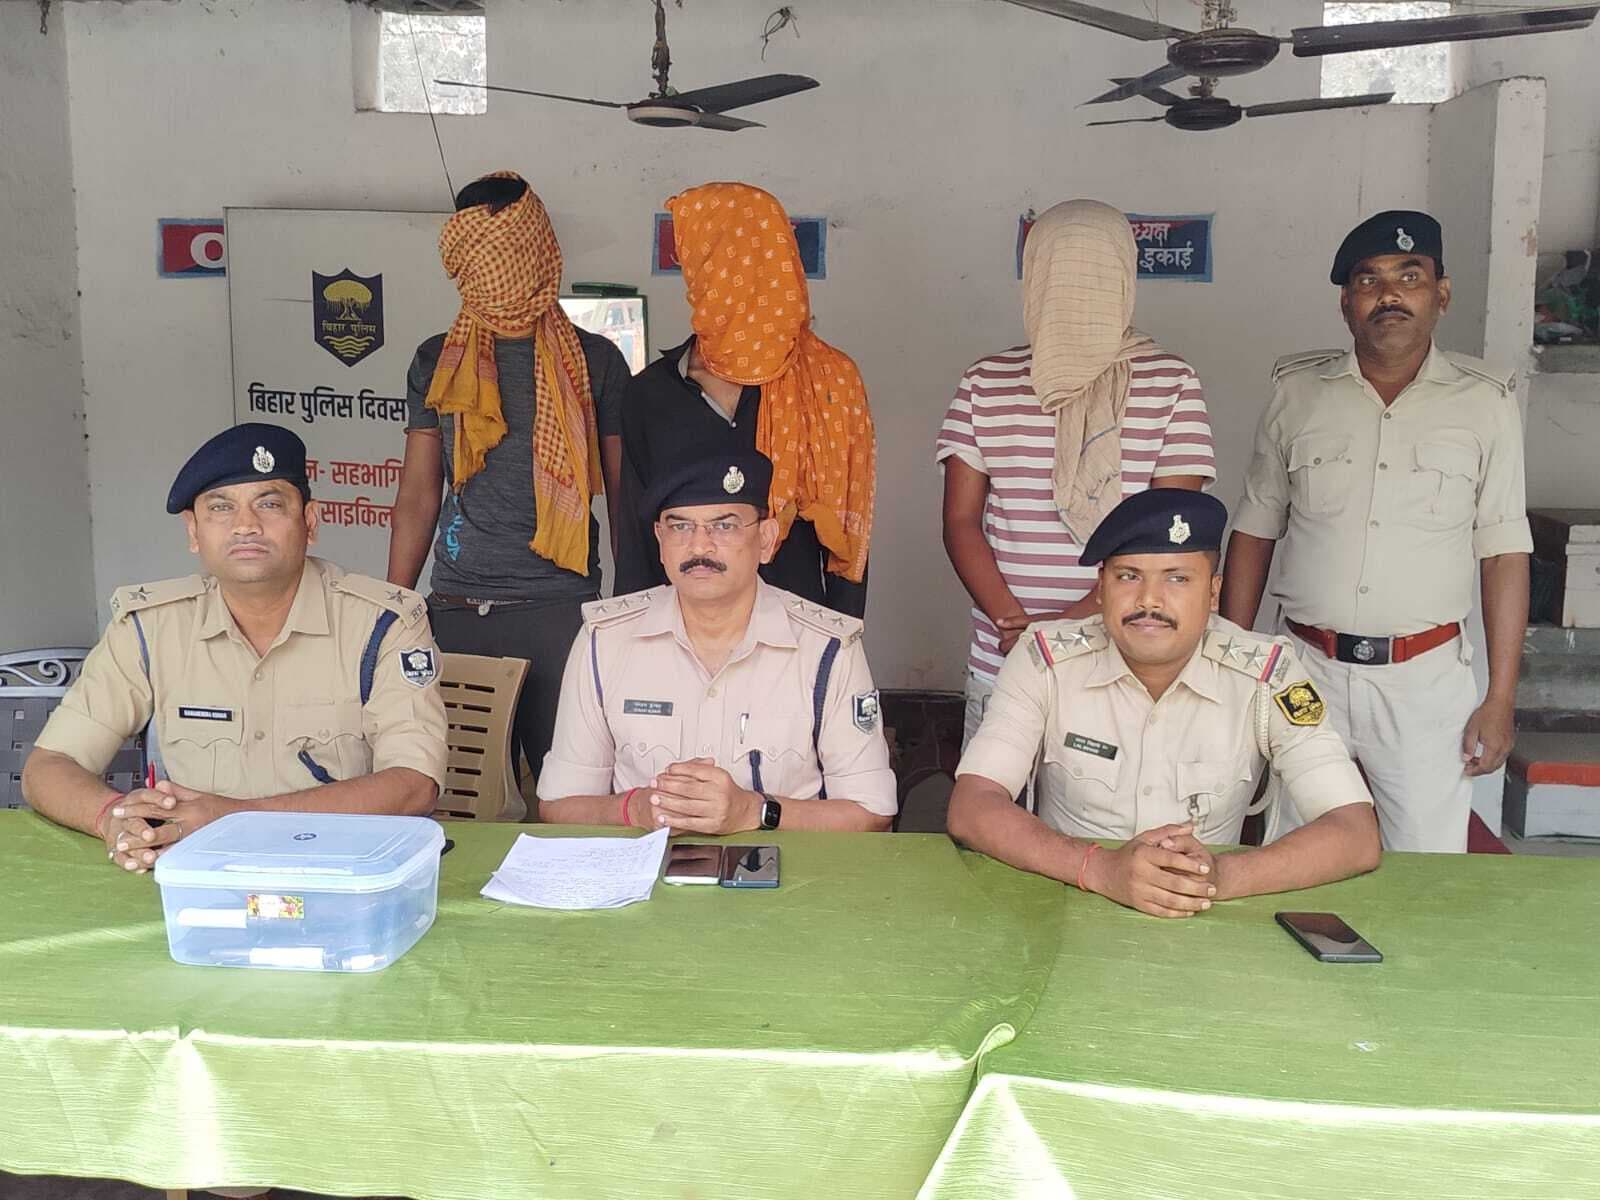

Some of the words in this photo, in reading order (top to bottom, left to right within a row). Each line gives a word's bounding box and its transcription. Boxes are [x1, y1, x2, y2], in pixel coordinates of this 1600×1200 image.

[1129, 222, 1171, 248] ध्यक्ष
[1139, 239, 1195, 273] इकाई
[248, 382, 297, 414] बिहार
[300, 386, 354, 423] पुलिस
[357, 389, 408, 422] दिवस
[329, 458, 404, 488] सहभागि
